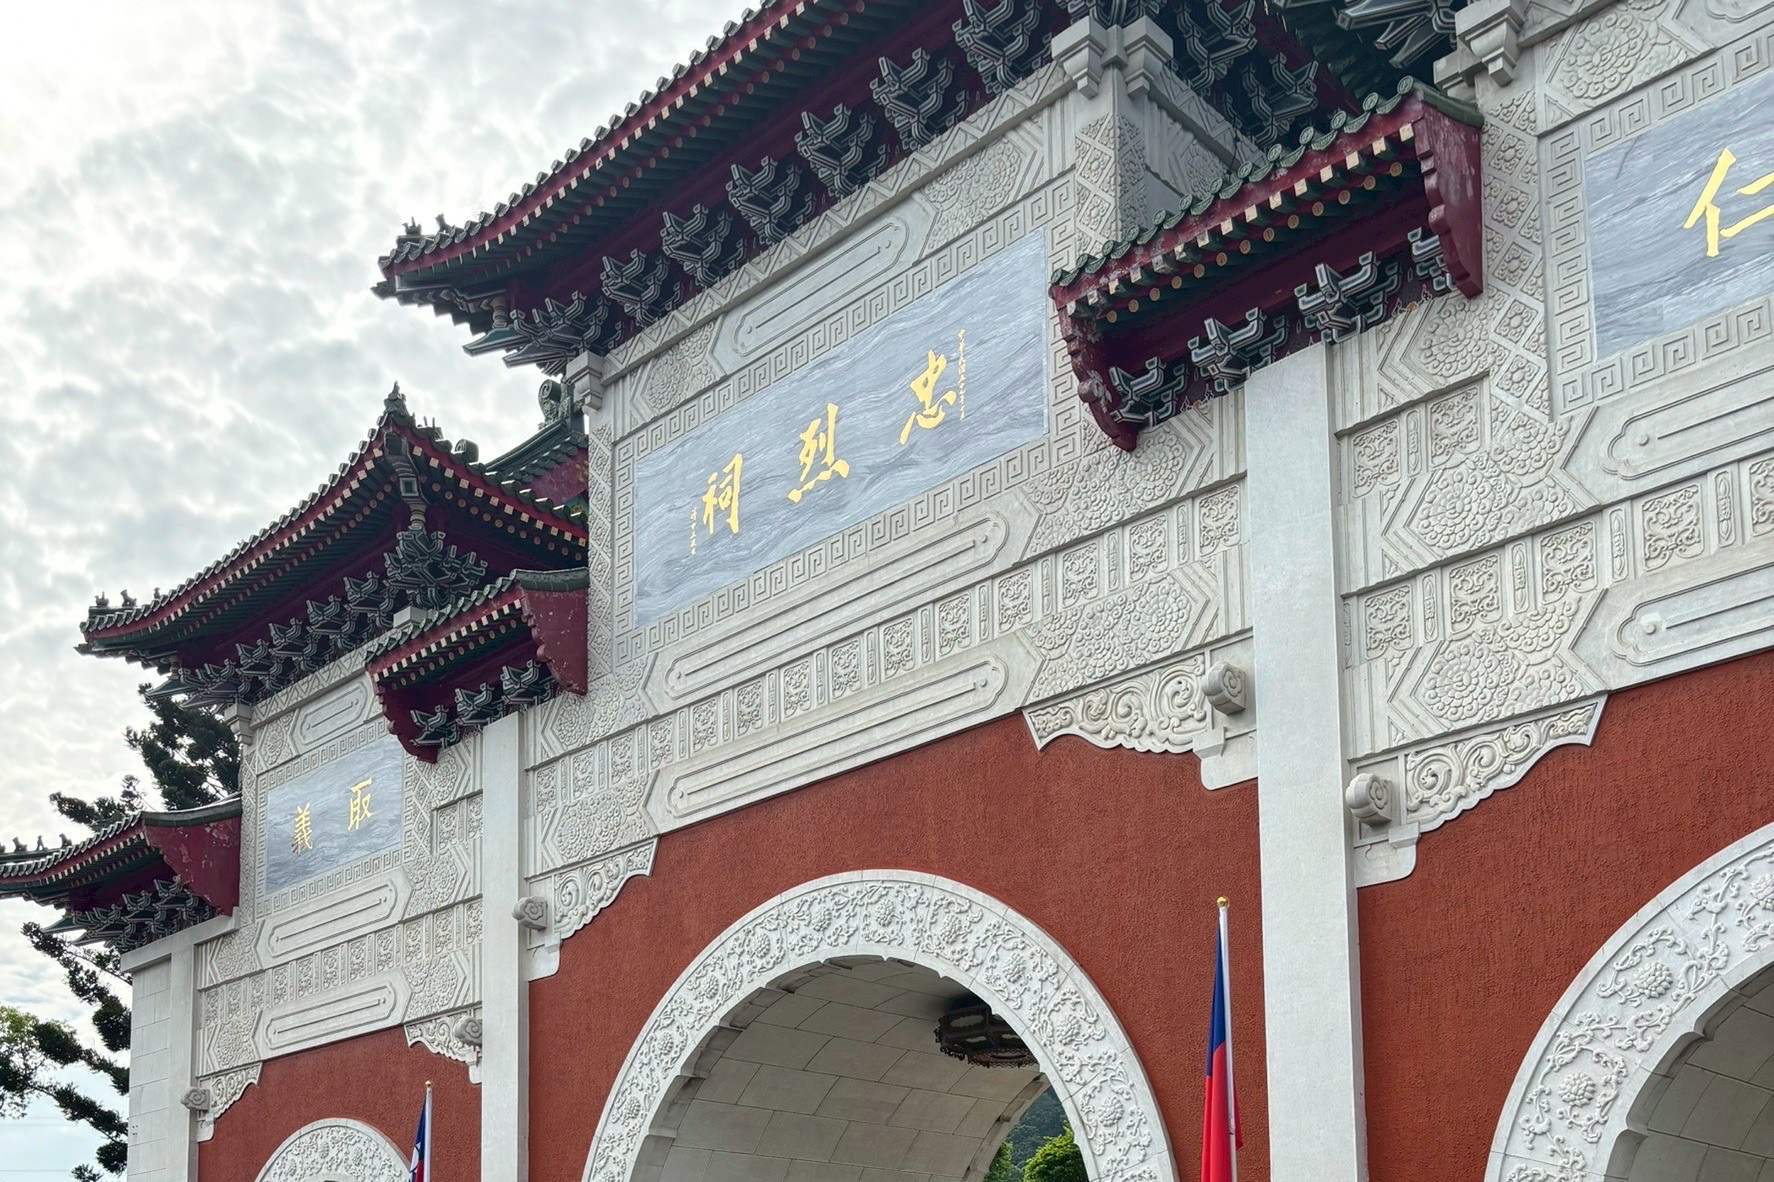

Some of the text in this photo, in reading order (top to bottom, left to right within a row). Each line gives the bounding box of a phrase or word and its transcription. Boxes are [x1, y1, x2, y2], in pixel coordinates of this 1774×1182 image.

[702, 350, 956, 534] 忠烈祠
[291, 778, 373, 857] 取義
